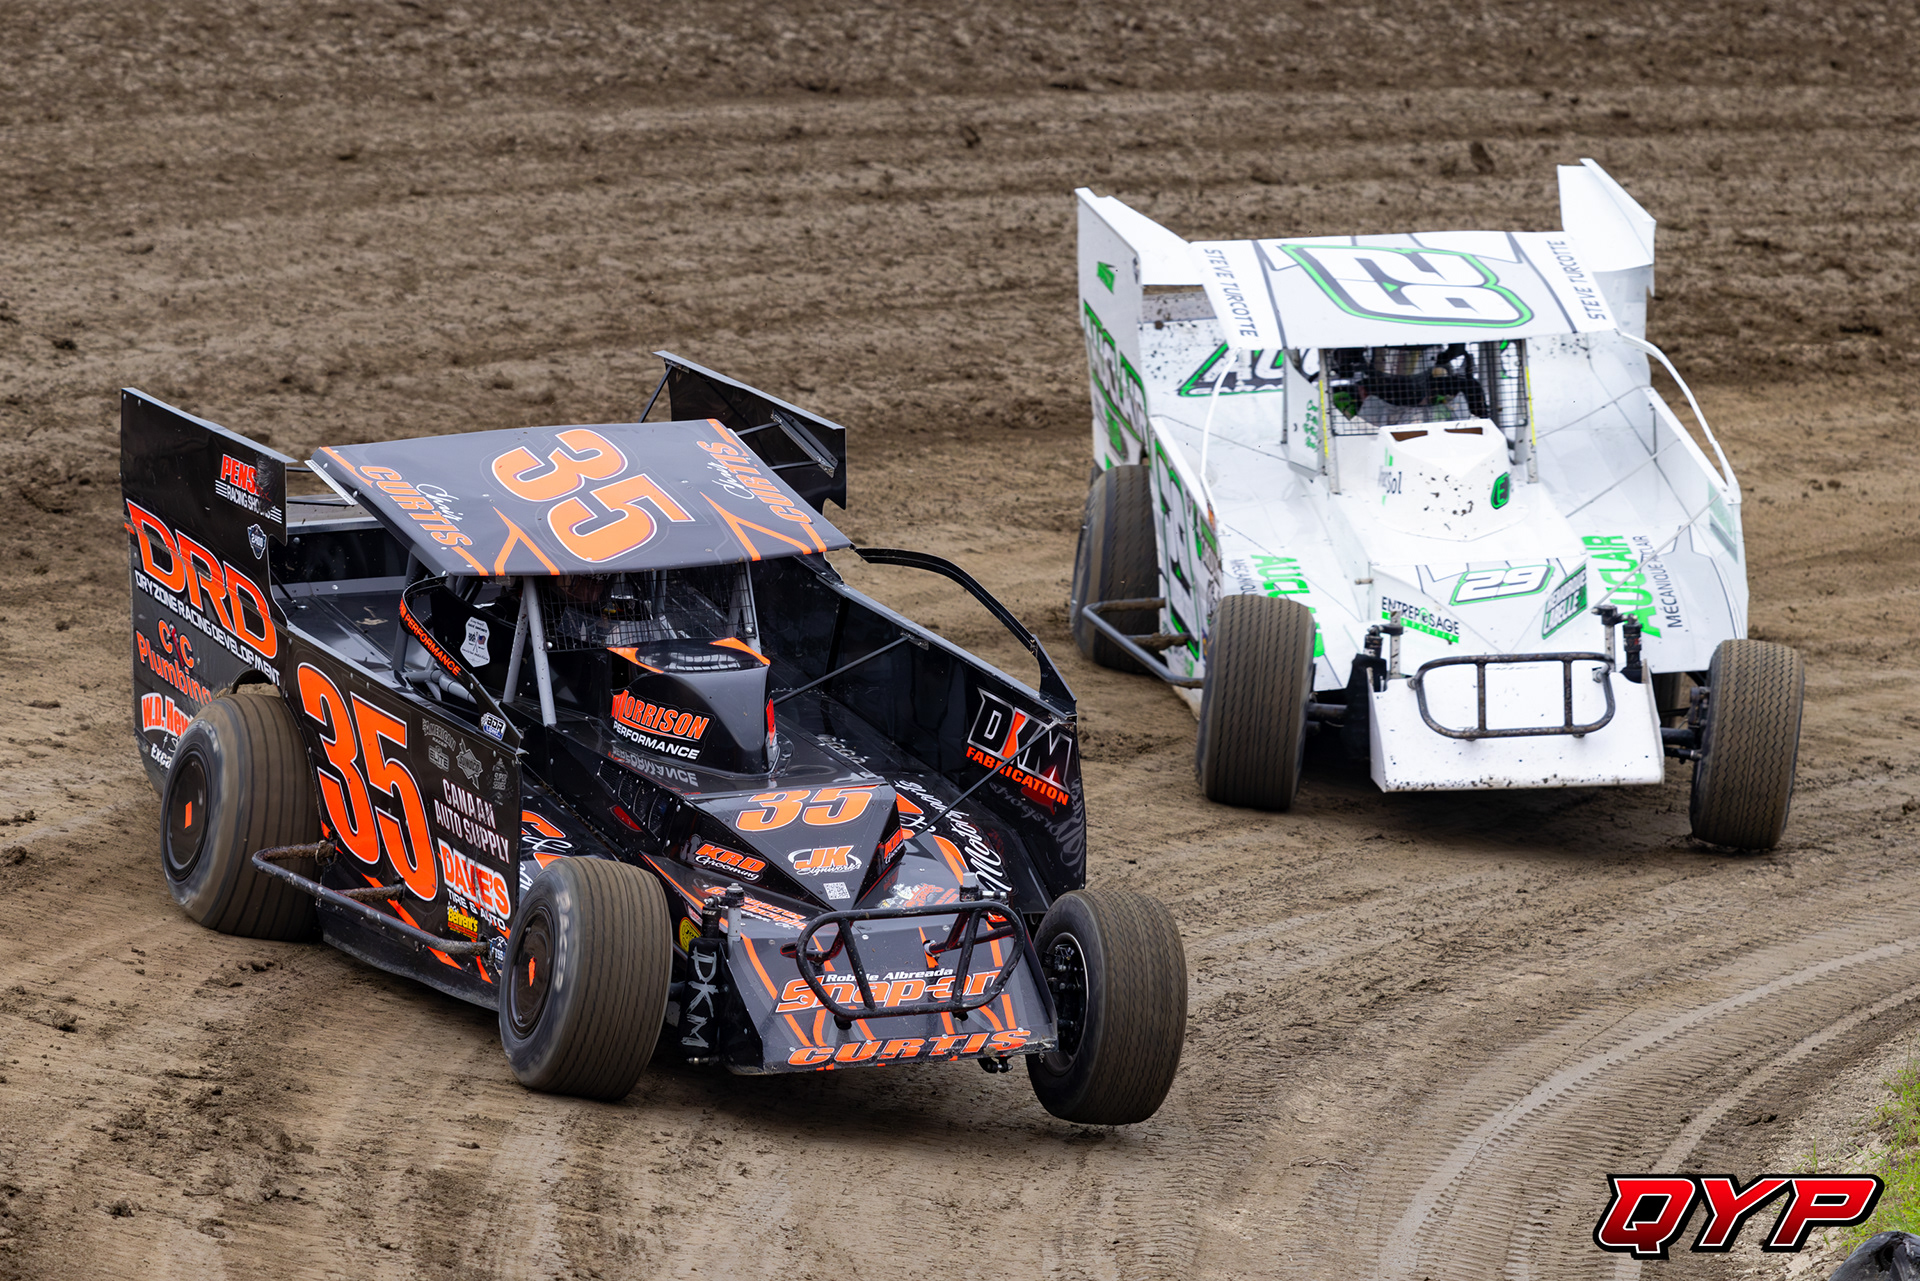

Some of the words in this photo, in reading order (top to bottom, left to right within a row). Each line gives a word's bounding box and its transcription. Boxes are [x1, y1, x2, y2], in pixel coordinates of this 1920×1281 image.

[1547, 240, 1589, 282] TURCOTTE
[1204, 248, 1235, 279] STEVE
[1220, 282, 1259, 337] TURCOTTE
[1574, 286, 1607, 320] STEVE
[360, 465, 473, 546] CURTIS
[492, 429, 696, 563] 35
[697, 440, 812, 524] CURTIS
[126, 499, 277, 659] DRD
[1452, 565, 1554, 604] 29
[134, 570, 154, 597] DRY
[152, 583, 178, 614] ZONE
[178, 598, 212, 640] RACING
[211, 626, 281, 687] DEVELOPMENT
[404, 612, 462, 676] PERFORMANCE
[141, 693, 165, 732] W.D.
[611, 689, 710, 740] MORRISON
[613, 720, 700, 760] PERFORMANCE
[298, 662, 437, 901] 35
[443, 779, 496, 829] CANAAN
[434, 799, 463, 839] AUTO
[463, 817, 510, 864] SUPPLY
[736, 785, 879, 831] 35
[438, 837, 511, 920] DAVE'S
[695, 842, 767, 873] KRD
[695, 855, 759, 881] Grooming
[793, 845, 854, 870] JK
[447, 888, 468, 910] TIRE
[480, 907, 506, 931] AUTO
[883, 968, 954, 980] Albreada
[788, 1029, 1031, 1066] CURTIS
